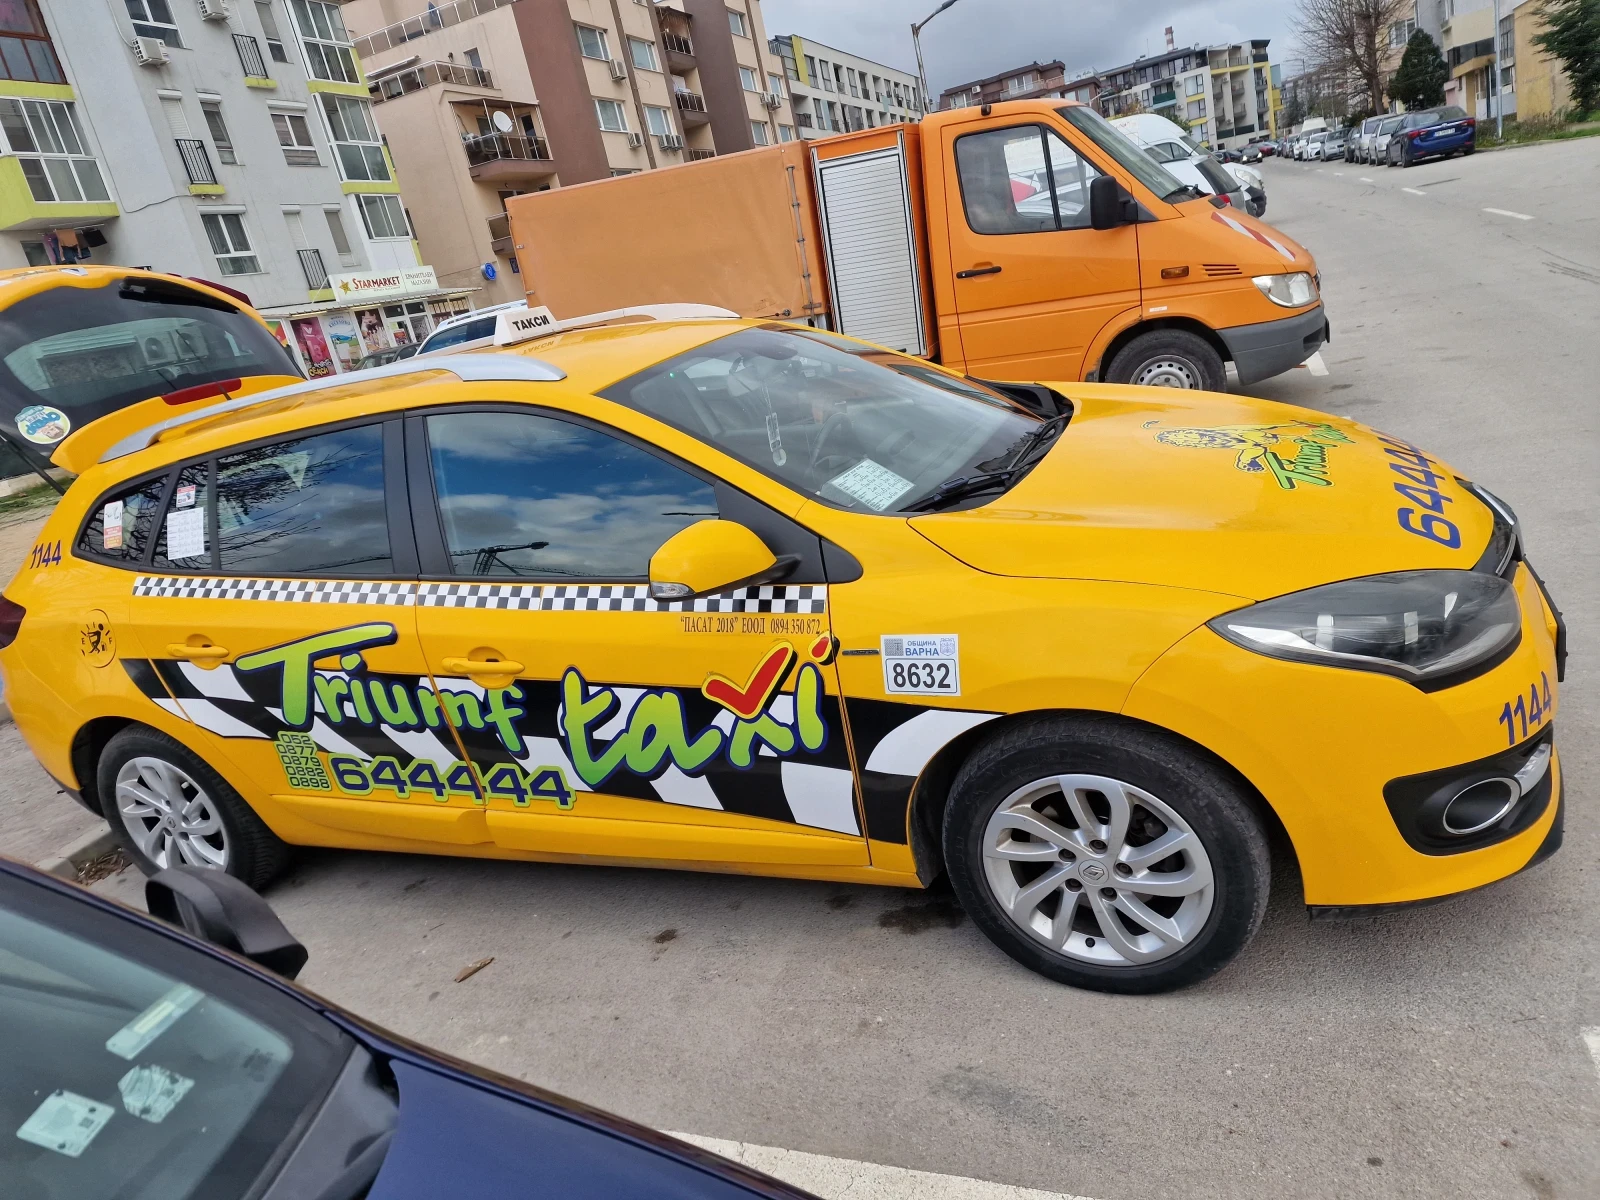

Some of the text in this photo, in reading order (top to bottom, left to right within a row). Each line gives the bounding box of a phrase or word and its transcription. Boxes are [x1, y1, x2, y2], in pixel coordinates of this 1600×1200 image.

[511, 314, 551, 331] ТАКСИ
[30, 540, 61, 569] 1144
[742, 617, 765, 635] ЕООД
[770, 618, 789, 634] 0894
[790, 619, 805, 634] 350
[806, 619, 821, 634] 872
[905, 648, 940, 656] ВАРНА
[892, 663, 951, 689] 8632
[232, 621, 839, 790] Triumf taxi
[1499, 670, 1552, 746] 1144
[281, 733, 311, 745] 052
[276, 743, 314, 756] 0877
[281, 755, 321, 768] 0879
[285, 765, 325, 778] 0882
[289, 776, 330, 789] 0898
[330, 757, 572, 806] 644444
